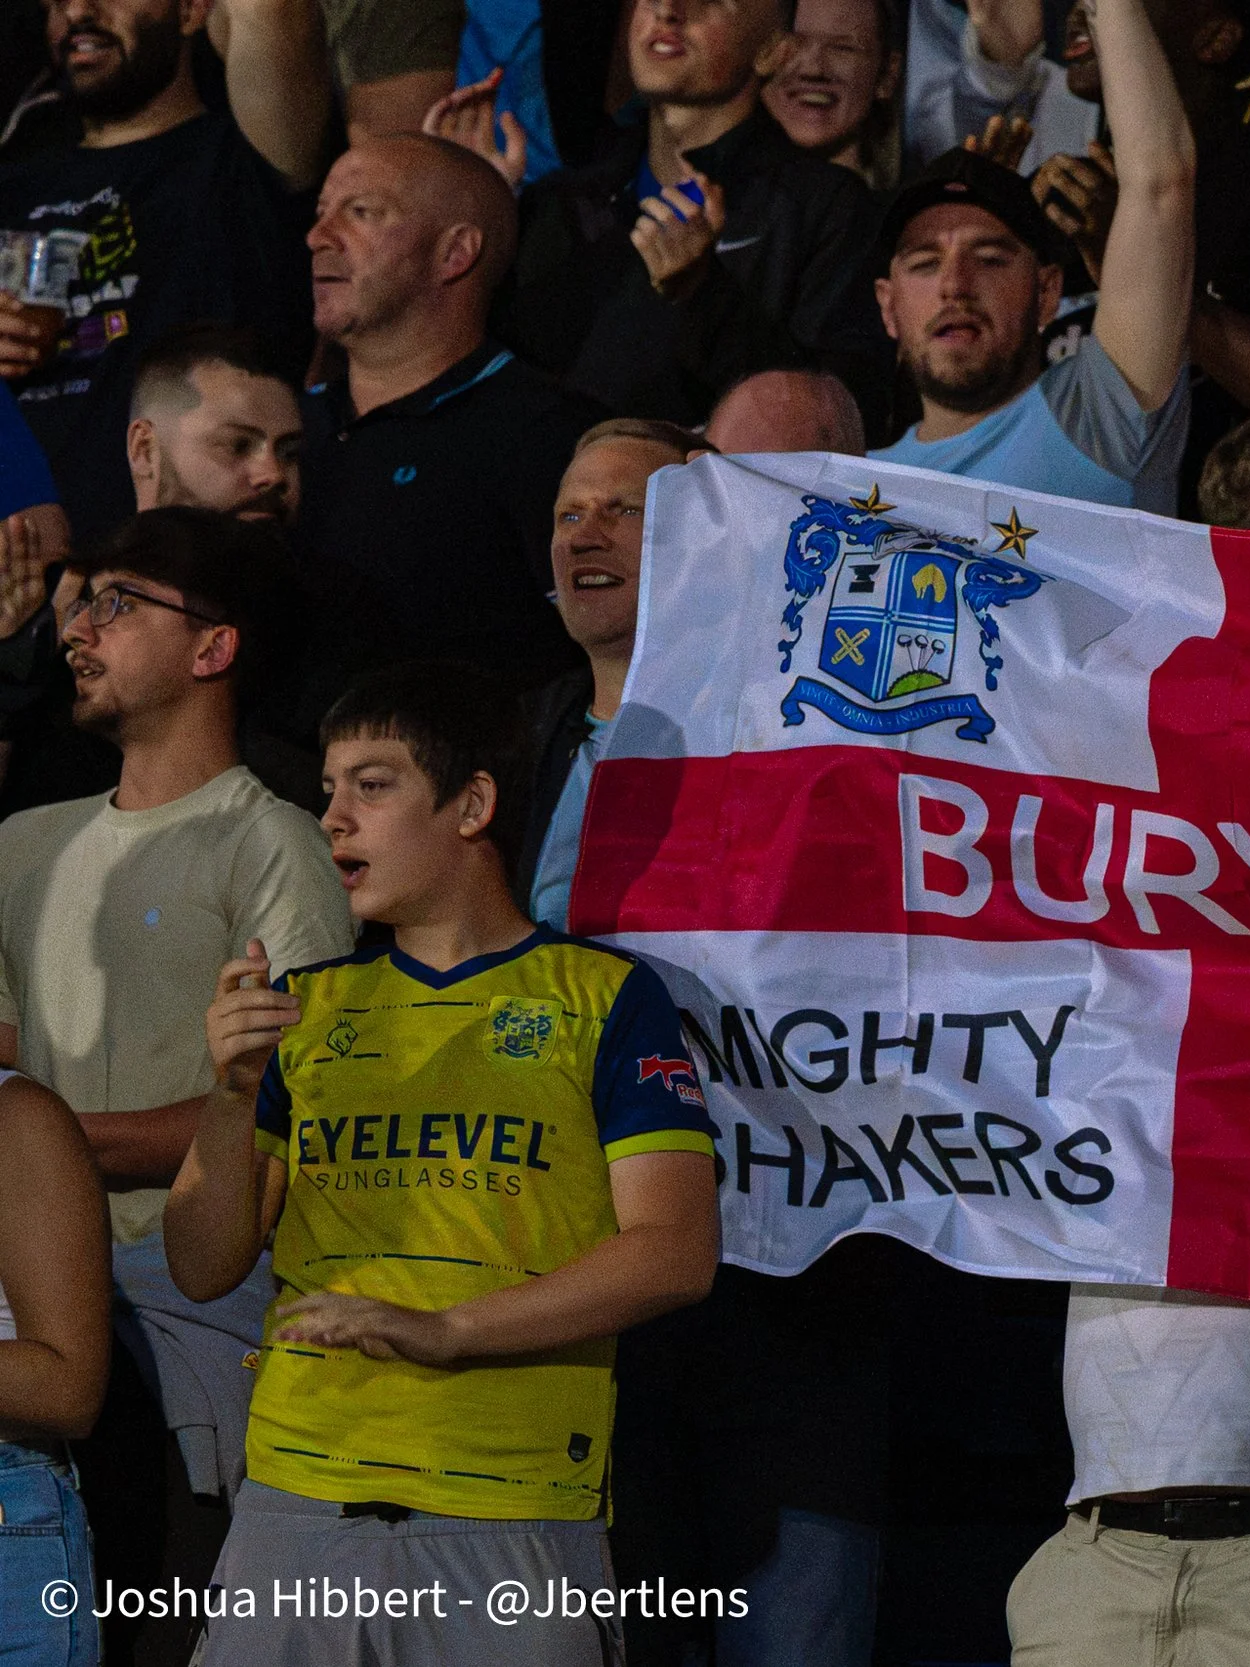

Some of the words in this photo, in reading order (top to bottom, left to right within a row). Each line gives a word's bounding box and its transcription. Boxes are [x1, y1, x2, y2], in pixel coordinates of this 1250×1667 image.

[896, 702, 972, 727] INDUSTRIA
[679, 1004, 1077, 1097] MIGHTY
[316, 1167, 522, 1197] SUNGLASSES
[715, 1110, 1115, 1207] HAKERS
